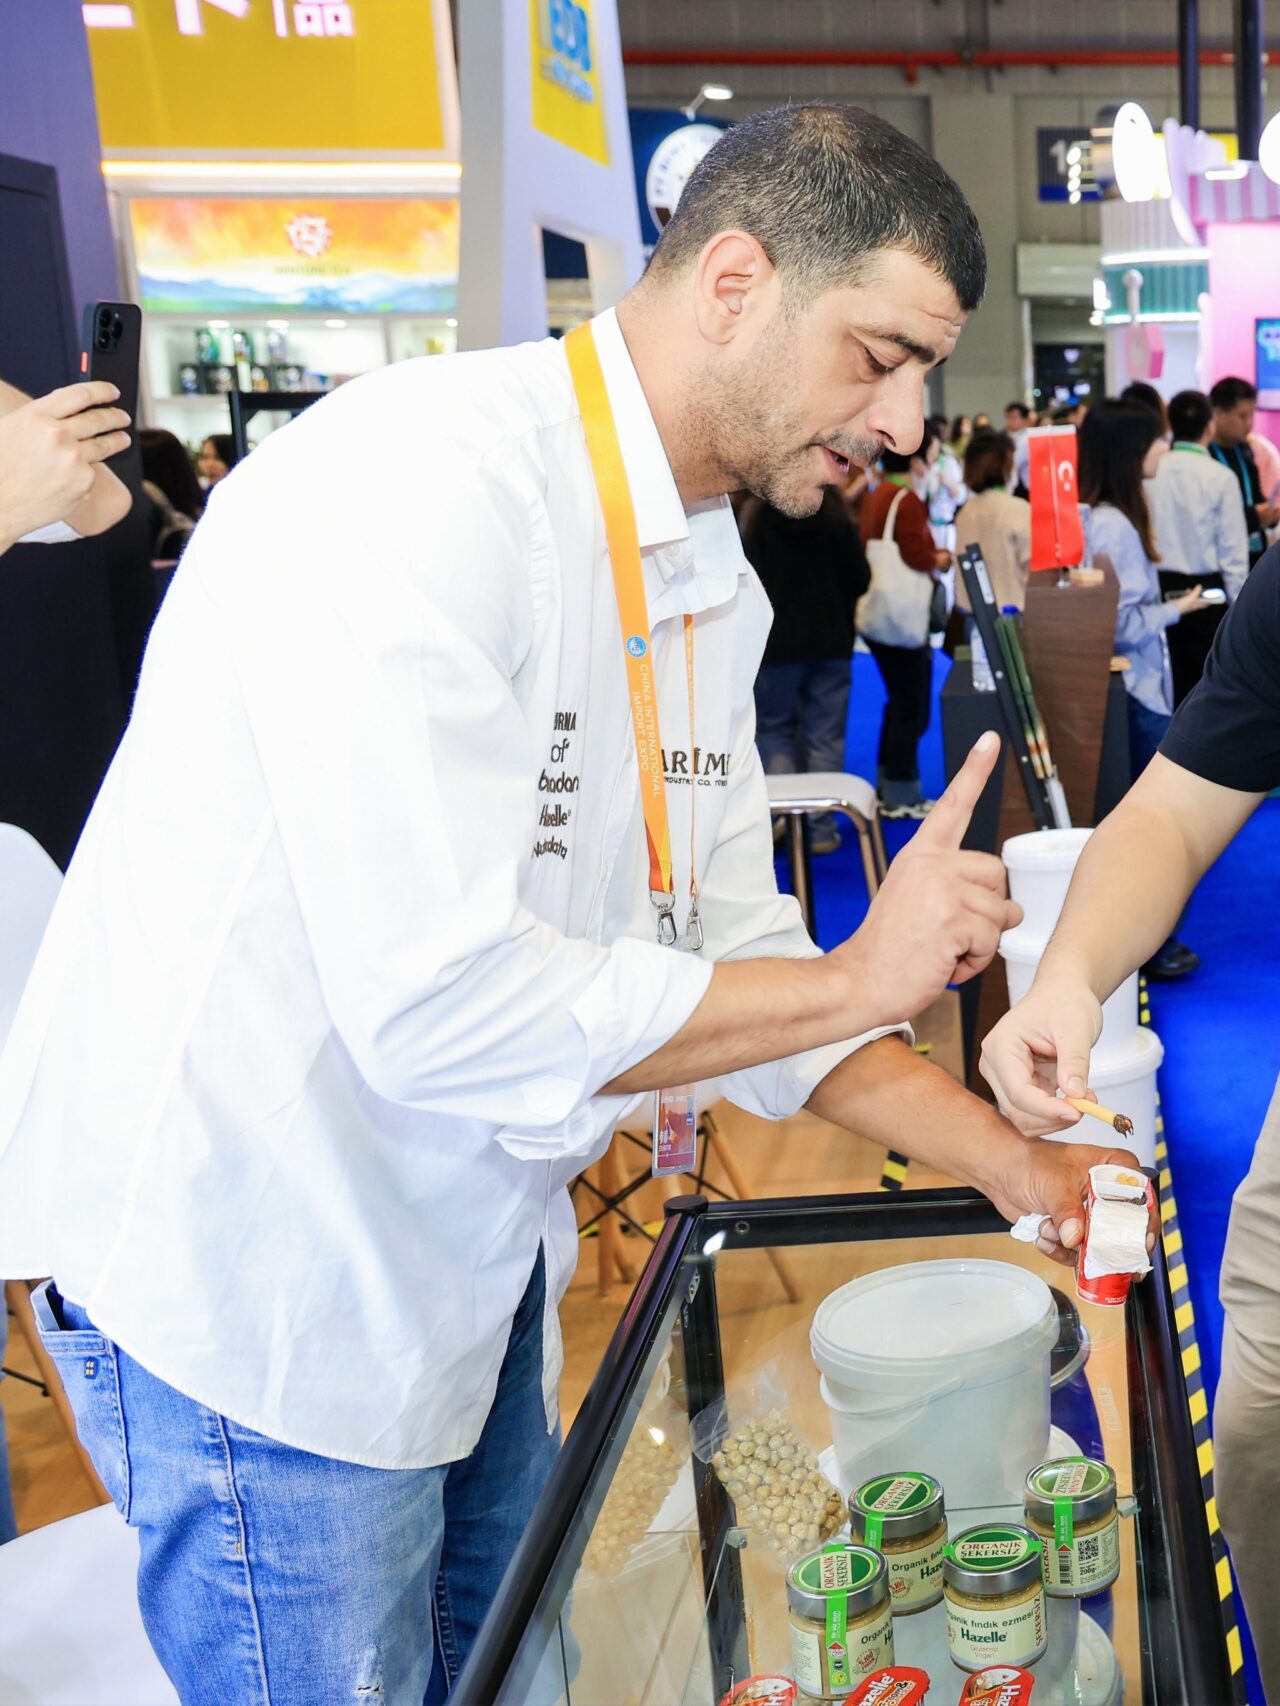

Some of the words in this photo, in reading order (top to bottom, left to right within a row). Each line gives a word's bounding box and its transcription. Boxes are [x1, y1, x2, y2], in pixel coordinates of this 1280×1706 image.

[633, 691, 646, 736] IMPORT
[640, 739, 649, 771] EXPO
[639, 663, 651, 702] CHINA
[645, 705, 661, 798] INTERNATIONAL
[892, 1557, 928, 1571] Organik
[971, 1620, 998, 1629] fındık
[1002, 1610, 1034, 1627] ezmesi
